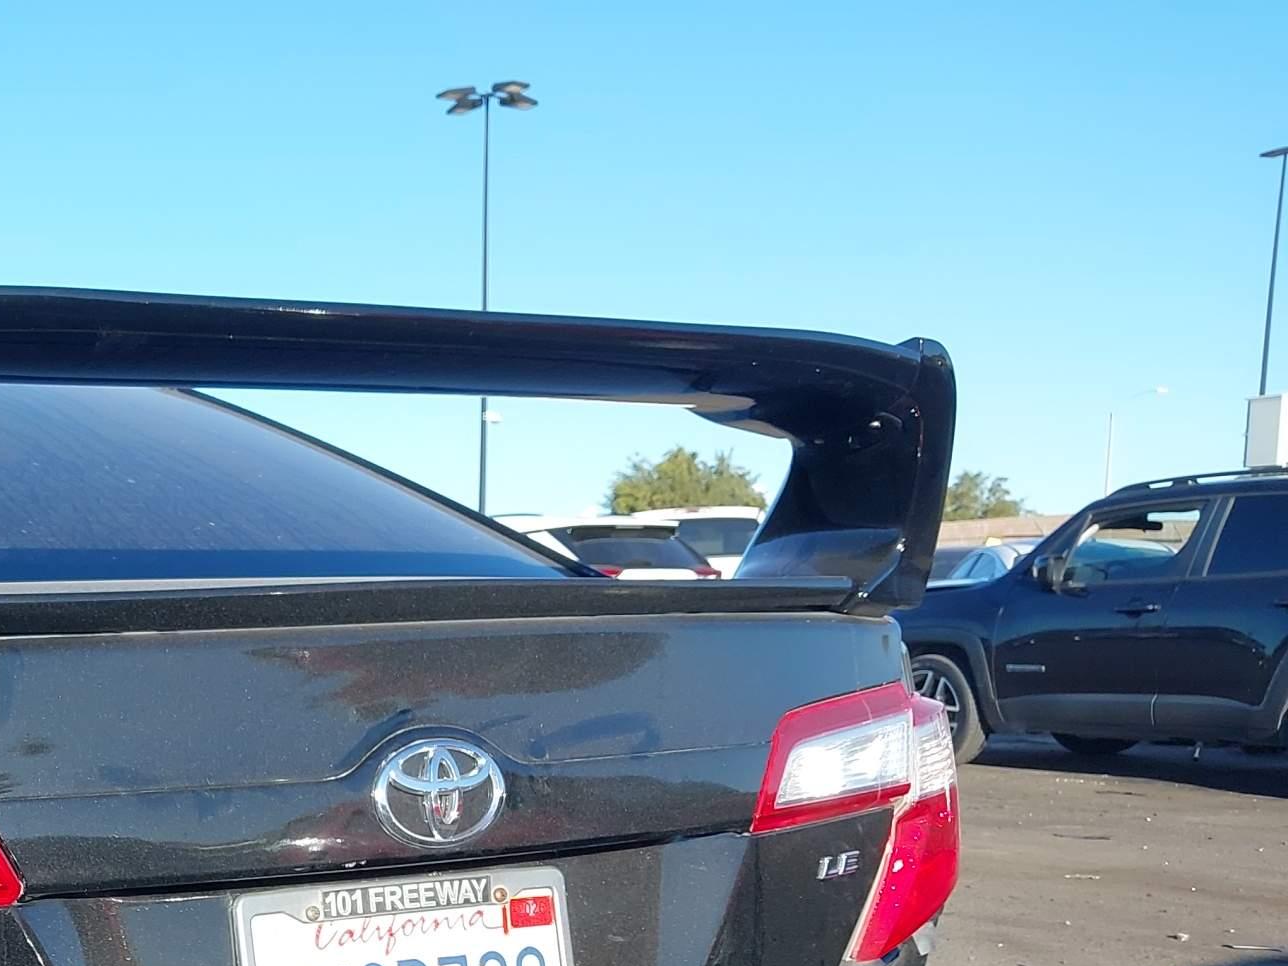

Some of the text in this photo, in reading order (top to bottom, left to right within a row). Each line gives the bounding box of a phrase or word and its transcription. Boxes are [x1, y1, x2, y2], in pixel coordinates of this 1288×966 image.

[816, 850, 860, 880] LE
[325, 878, 488, 917] 101 FREEWAY
[314, 909, 502, 956] California
